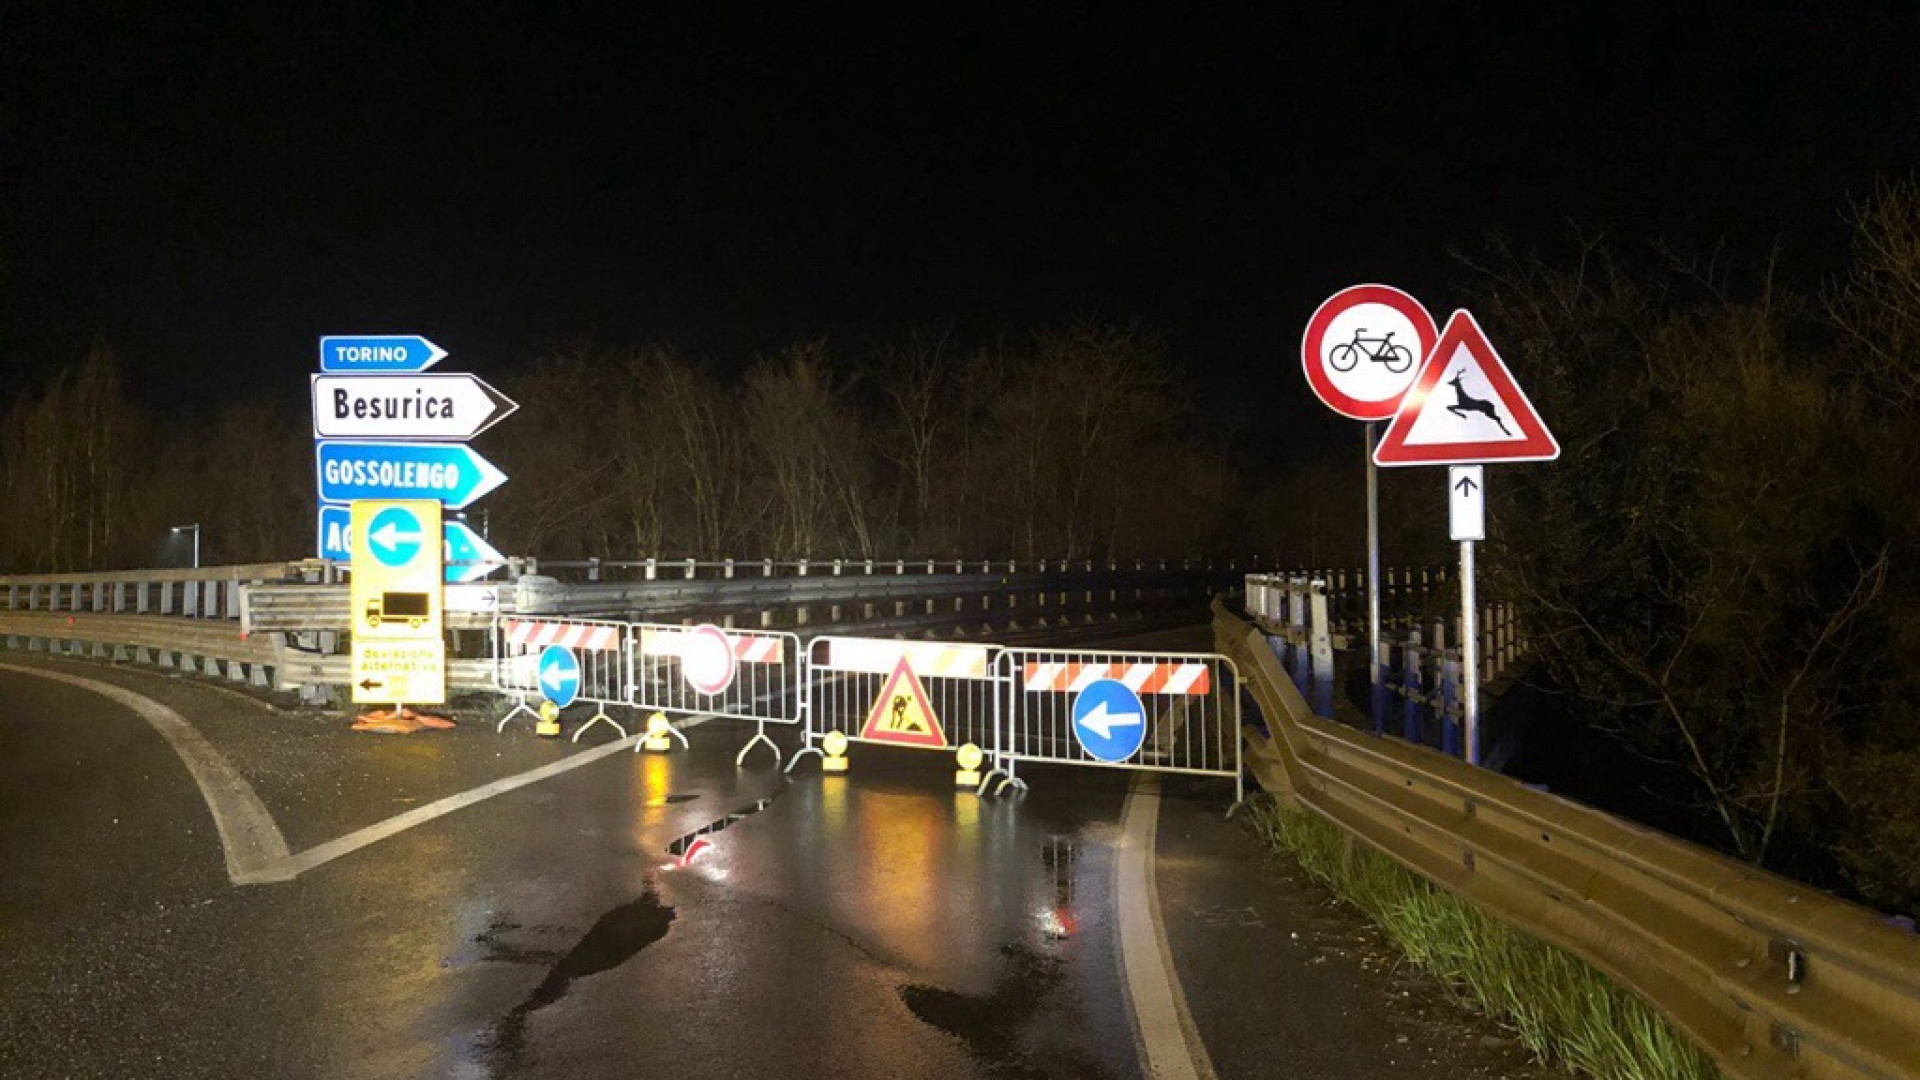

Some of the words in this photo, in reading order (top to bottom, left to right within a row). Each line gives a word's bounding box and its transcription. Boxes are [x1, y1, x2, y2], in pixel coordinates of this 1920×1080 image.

[335, 346, 408, 363] TORINO
[333, 388, 455, 419] Besurica
[325, 459, 460, 489] GOSSOLENGO
